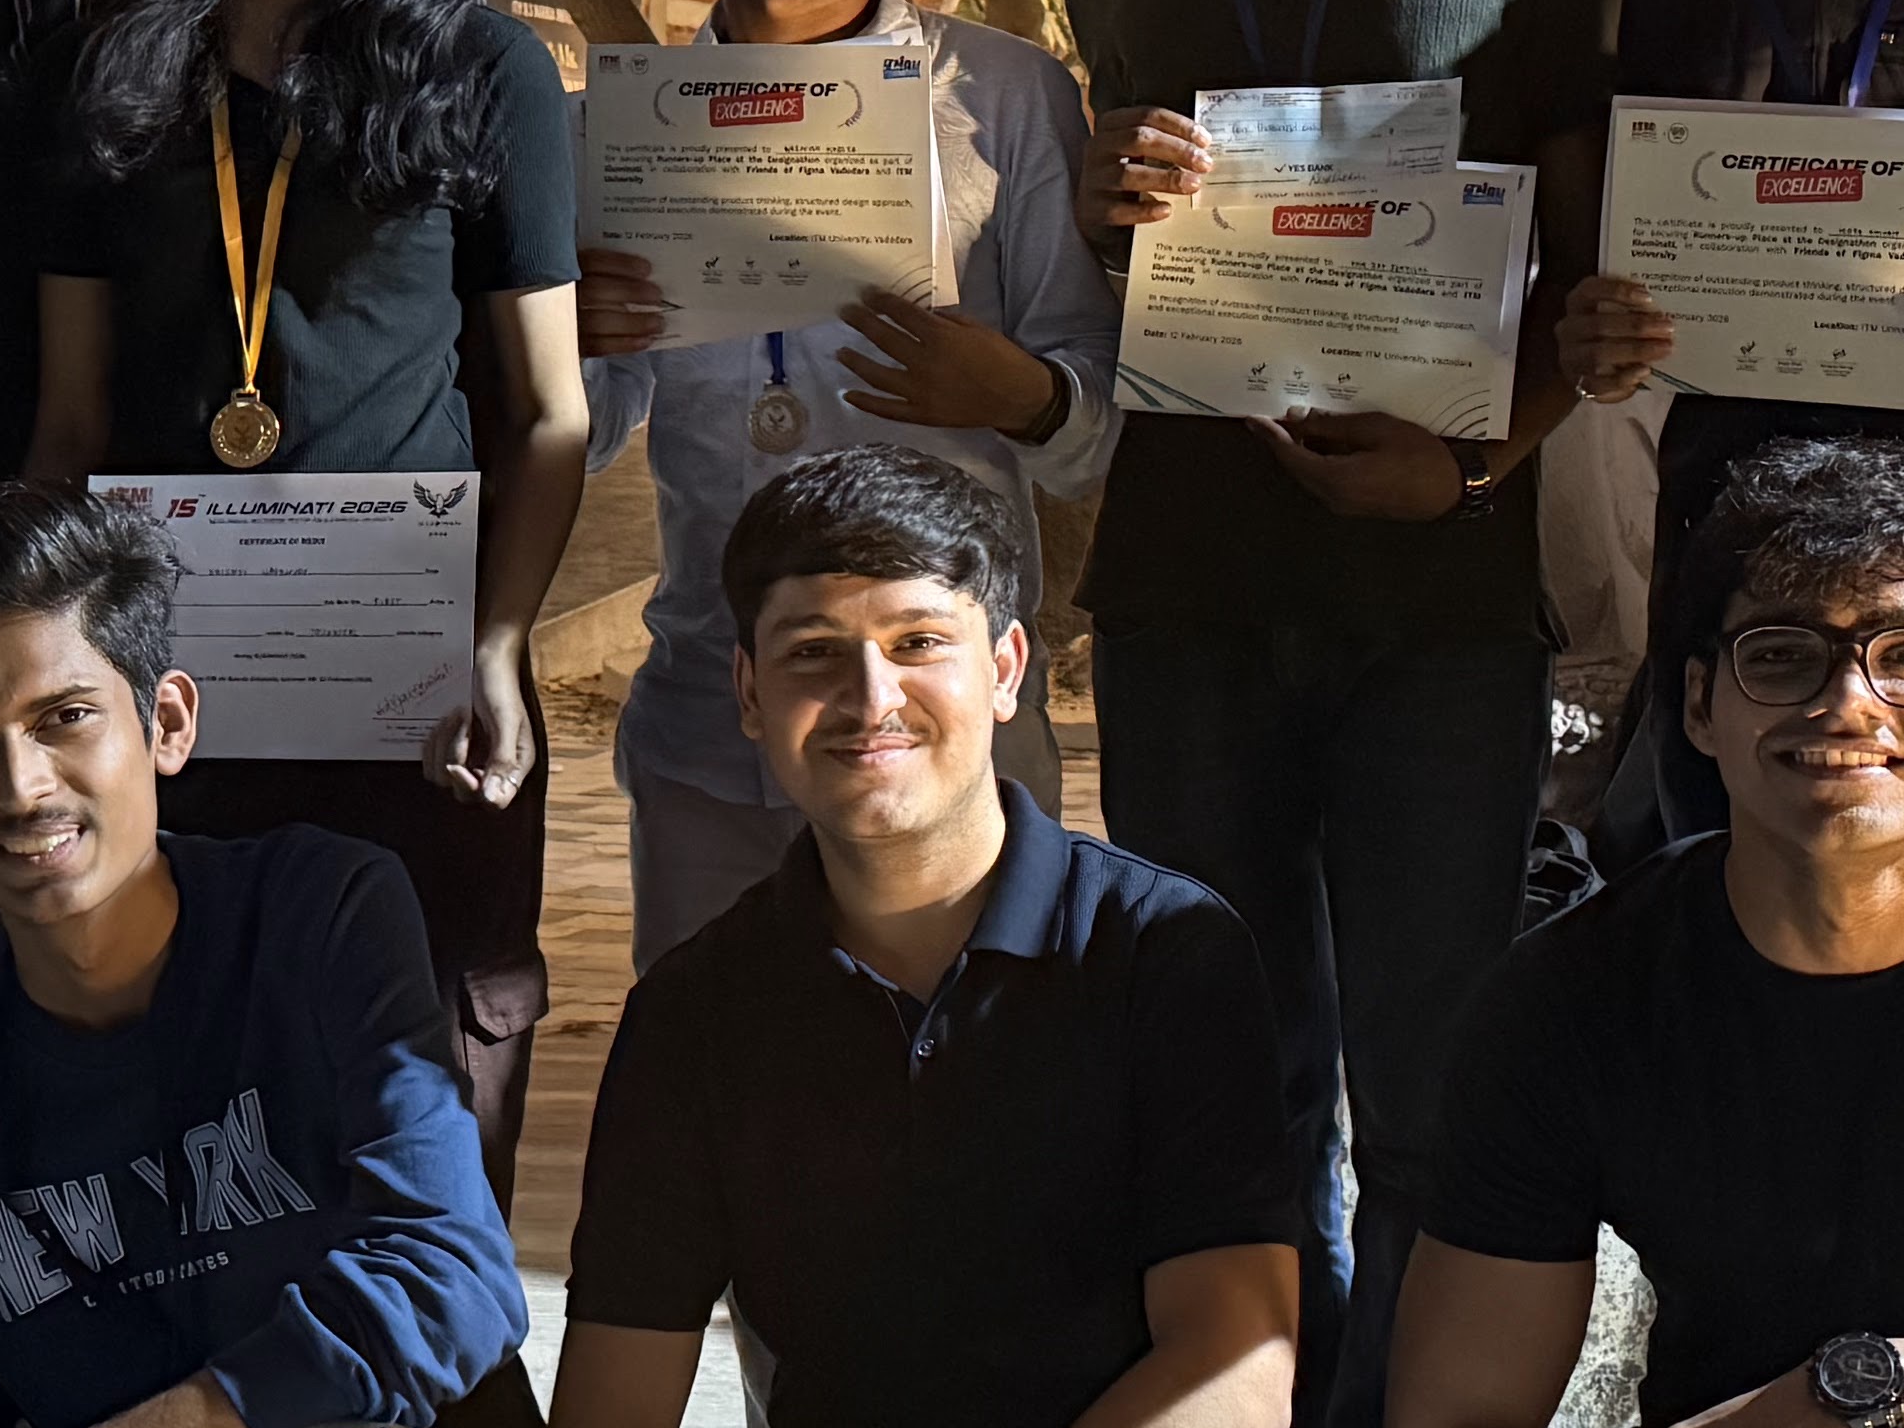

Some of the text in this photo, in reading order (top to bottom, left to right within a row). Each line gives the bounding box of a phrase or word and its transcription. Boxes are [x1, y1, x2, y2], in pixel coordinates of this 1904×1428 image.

[679, 82, 838, 96] CERTIFICATE OF
[714, 98, 800, 121] EXCELLENCE
[1721, 154, 1904, 176] CERTIFICATE OF
[1762, 175, 1858, 197] EXCELLENCE
[1381, 201, 1412, 217] OF
[1277, 213, 1367, 231] EXCELLENCE
[166, 498, 409, 519] 15 ILLUMINATI 2026
[130, 1087, 316, 1236] YRK
